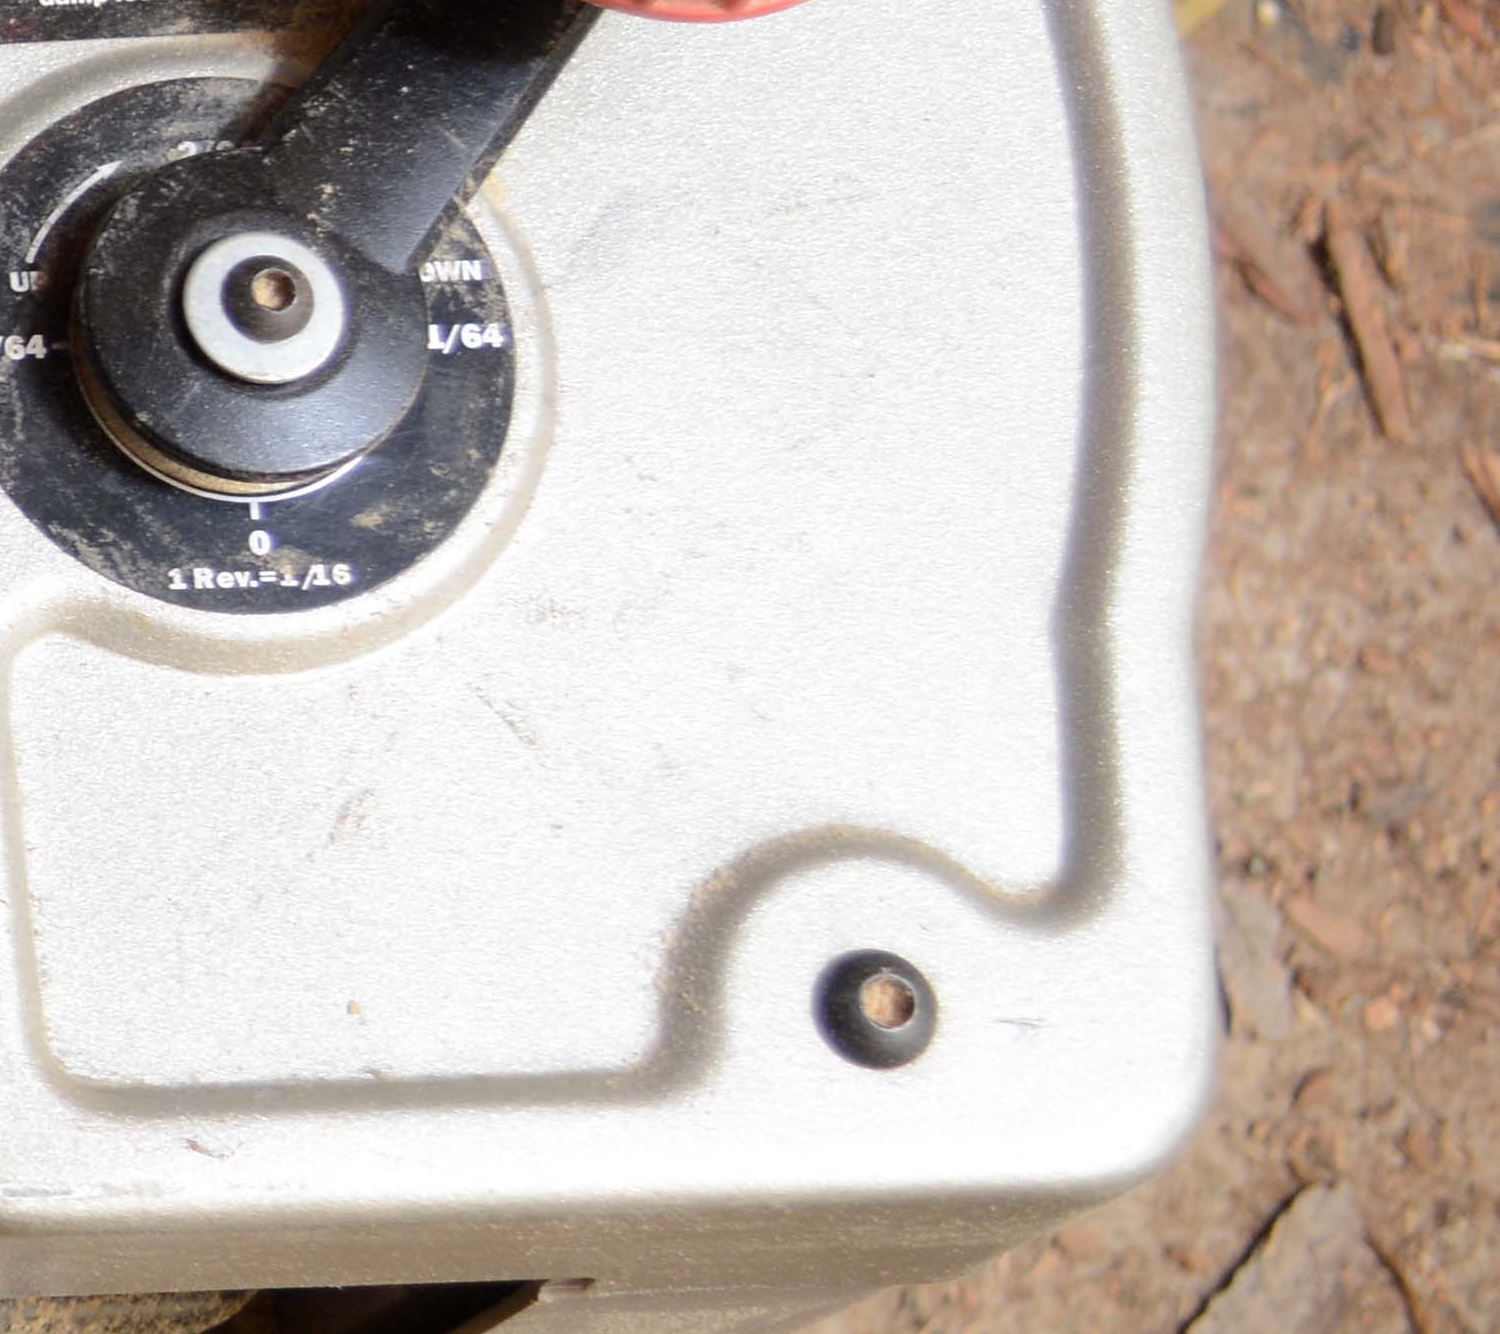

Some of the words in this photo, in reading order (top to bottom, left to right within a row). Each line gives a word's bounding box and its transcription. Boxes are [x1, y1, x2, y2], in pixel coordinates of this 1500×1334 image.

[420, 259, 482, 282] OWN
[428, 323, 504, 355] 1/64
[249, 532, 272, 553] 0
